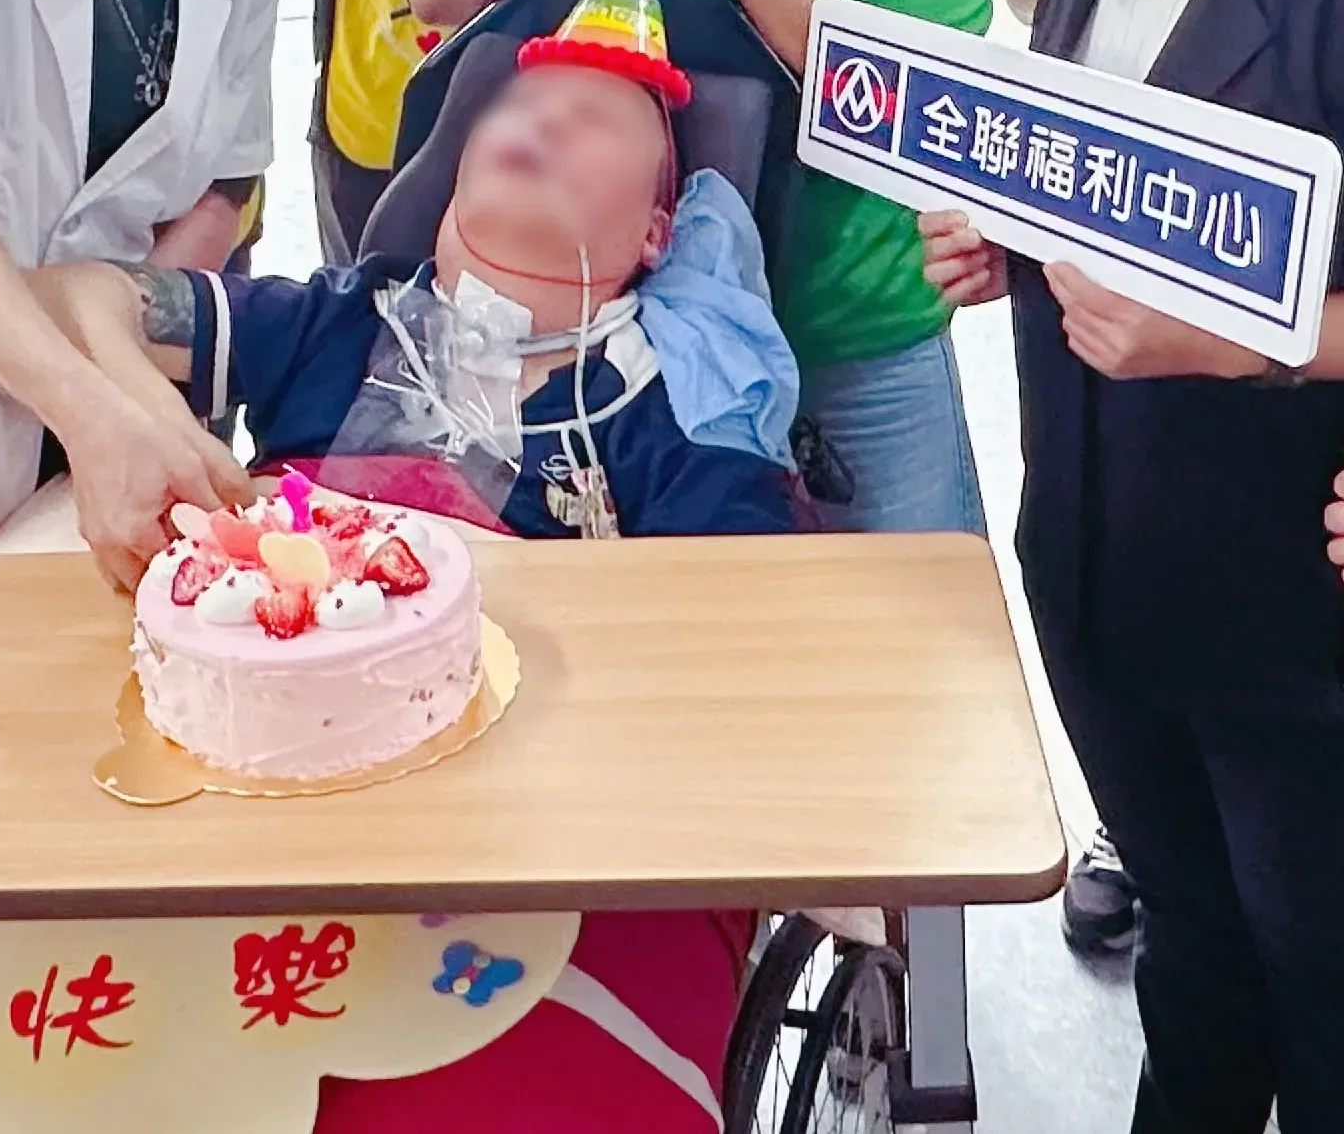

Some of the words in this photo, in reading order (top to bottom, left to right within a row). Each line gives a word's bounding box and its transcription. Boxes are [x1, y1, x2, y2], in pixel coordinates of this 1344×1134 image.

[919, 93, 1262, 269] 全聯福利中心
[10, 921, 360, 1063] 快樂
